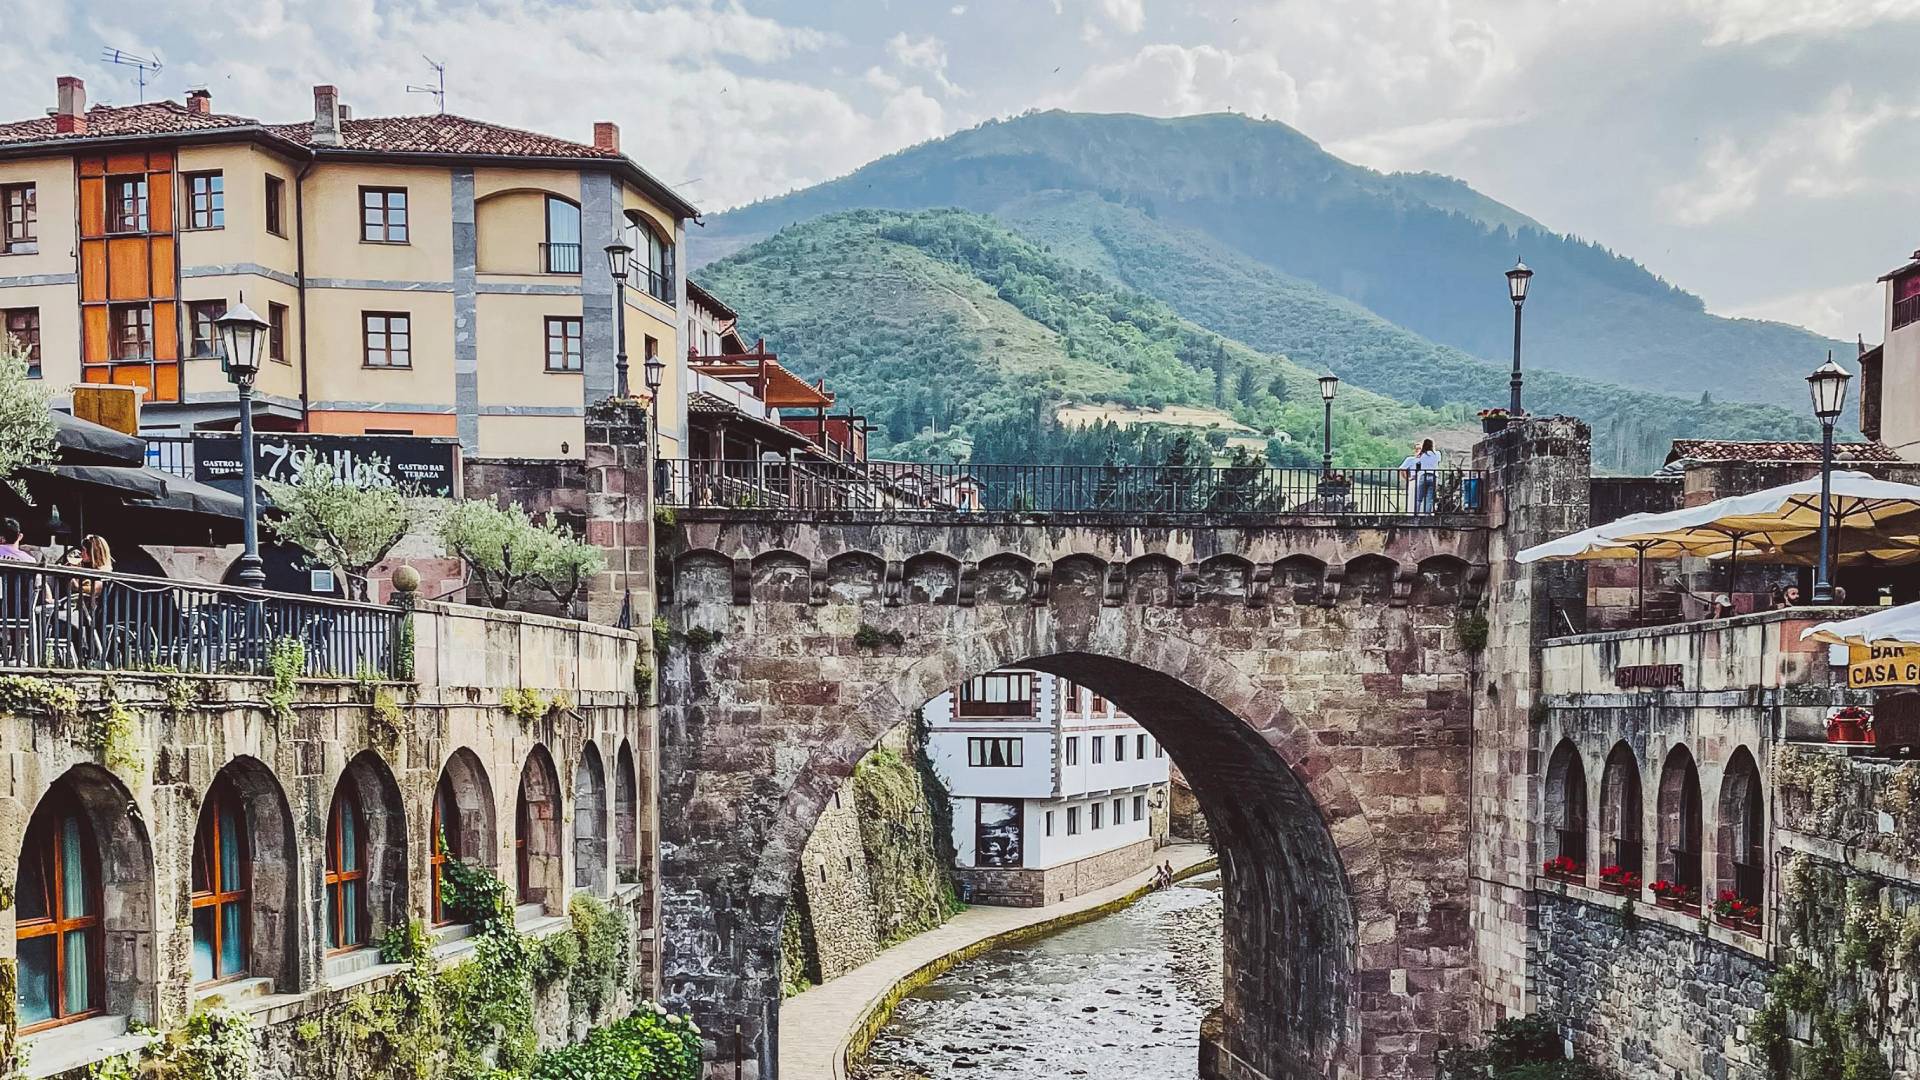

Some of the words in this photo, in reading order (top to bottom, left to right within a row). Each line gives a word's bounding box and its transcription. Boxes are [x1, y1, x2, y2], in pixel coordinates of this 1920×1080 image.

[260, 442, 289, 479] 7
[398, 463, 428, 471] GASTRO
[405, 471, 439, 479] TERRAZA
[1871, 646, 1905, 659] BAR
[1853, 663, 1898, 684] CASA
[1906, 663, 1920, 681] G
